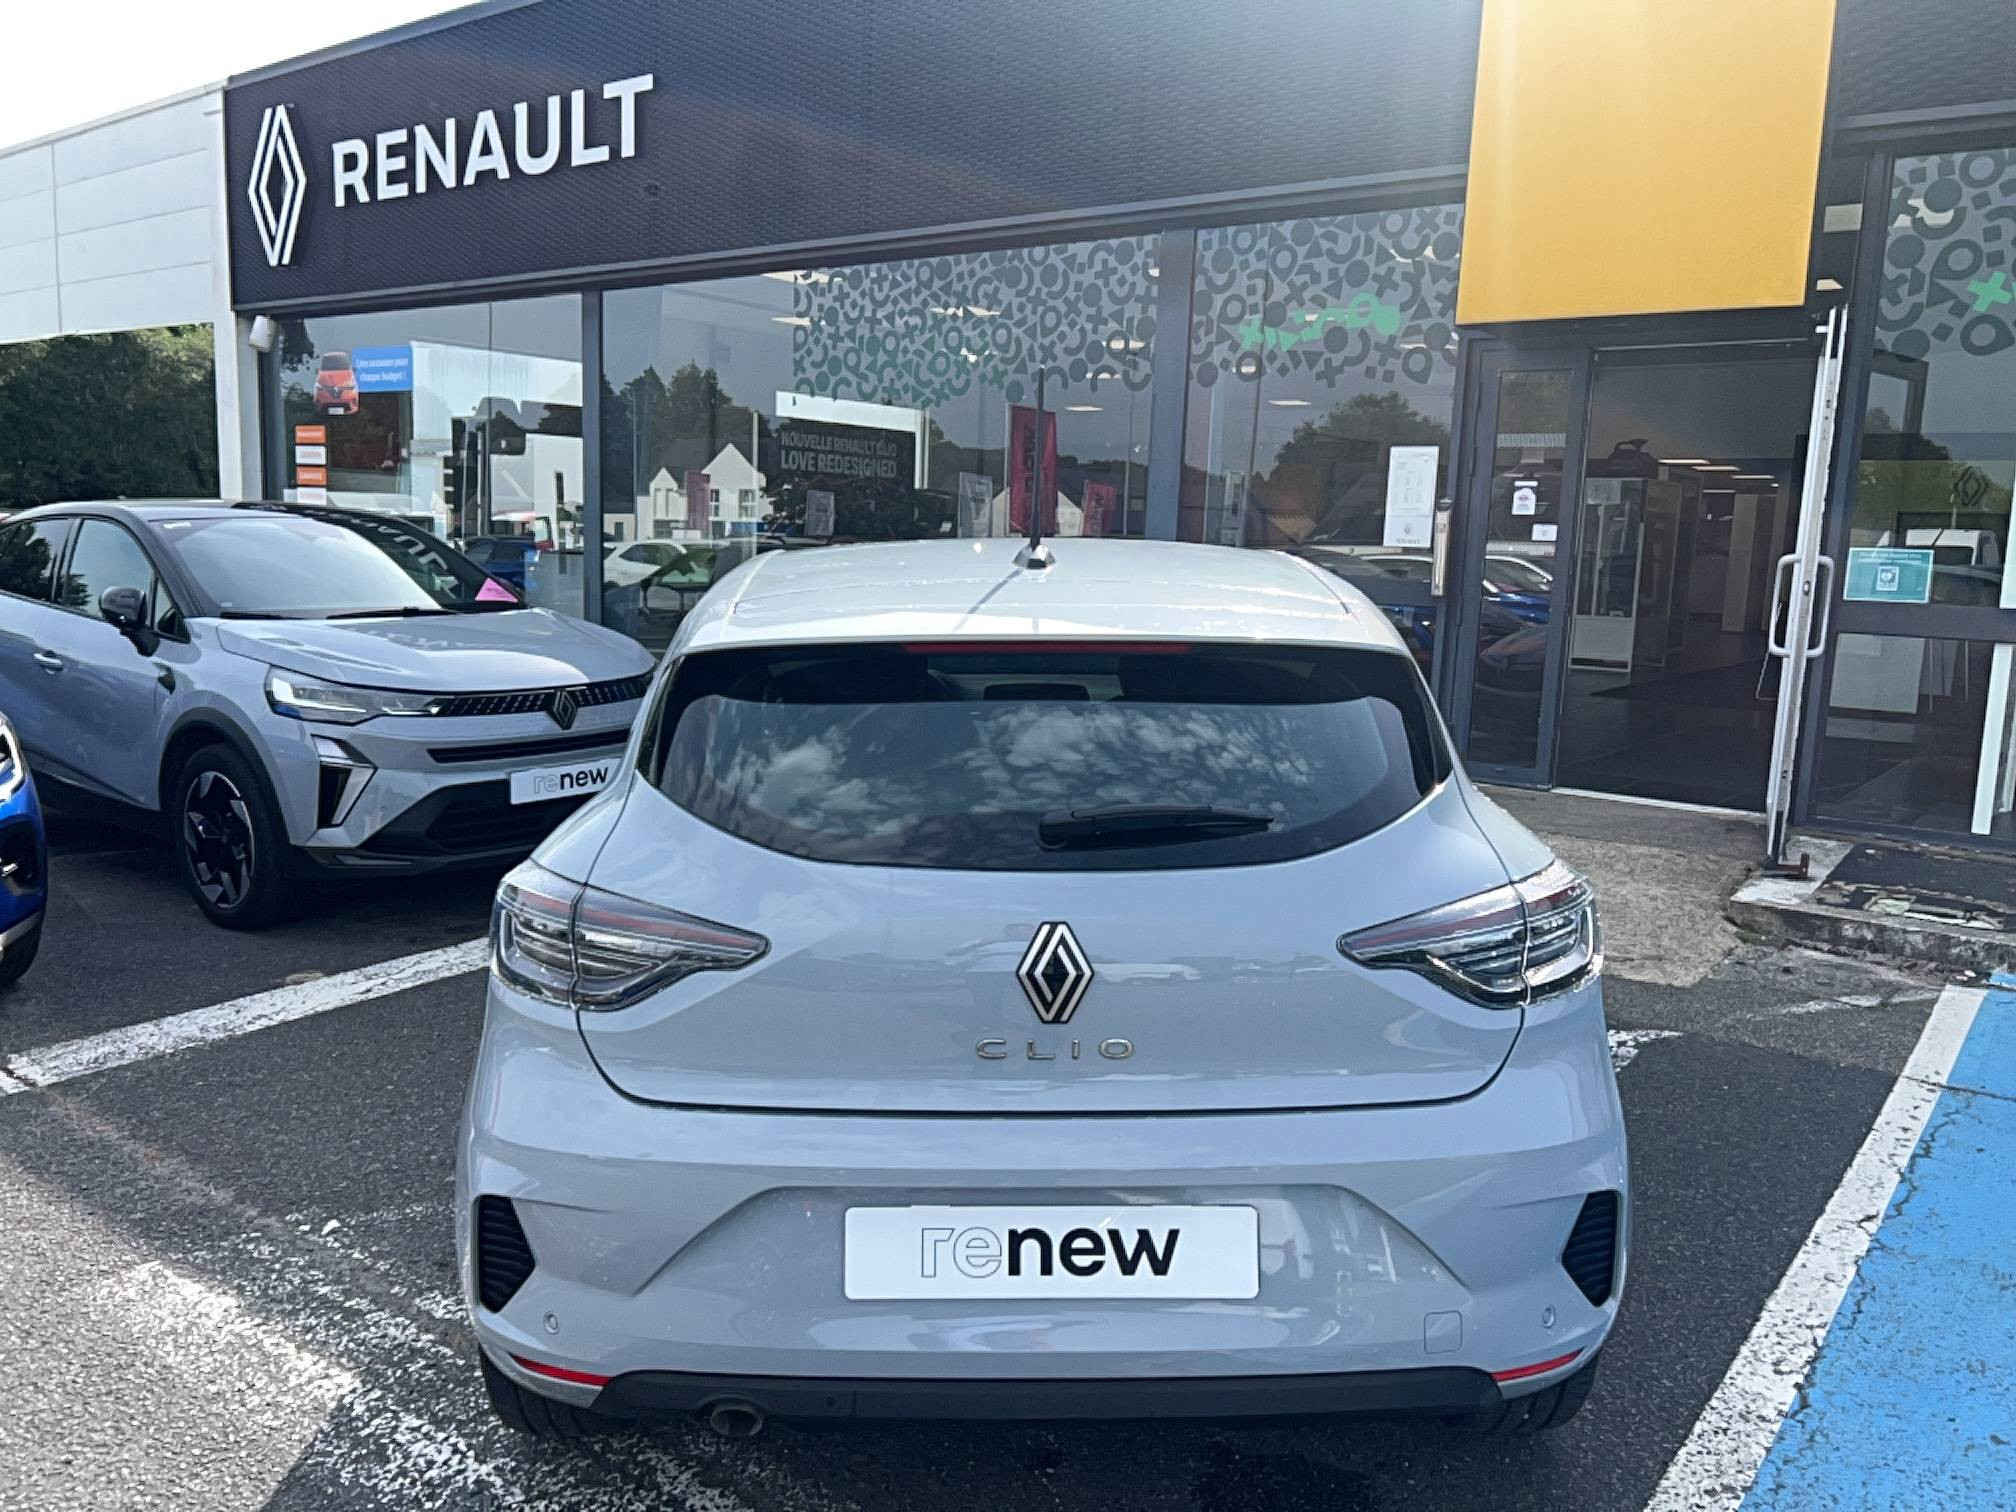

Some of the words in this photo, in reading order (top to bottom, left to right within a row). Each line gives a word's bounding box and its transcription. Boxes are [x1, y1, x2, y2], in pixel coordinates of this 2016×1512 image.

[331, 73, 654, 208] RENAULT
[781, 431, 833, 451] NOUVELLE
[781, 449, 816, 472] LOVE
[817, 454, 898, 478] REDESIGNED
[533, 767, 608, 794] renew
[975, 1038, 1135, 1060] CLIO
[922, 1227, 1180, 1278] renew
